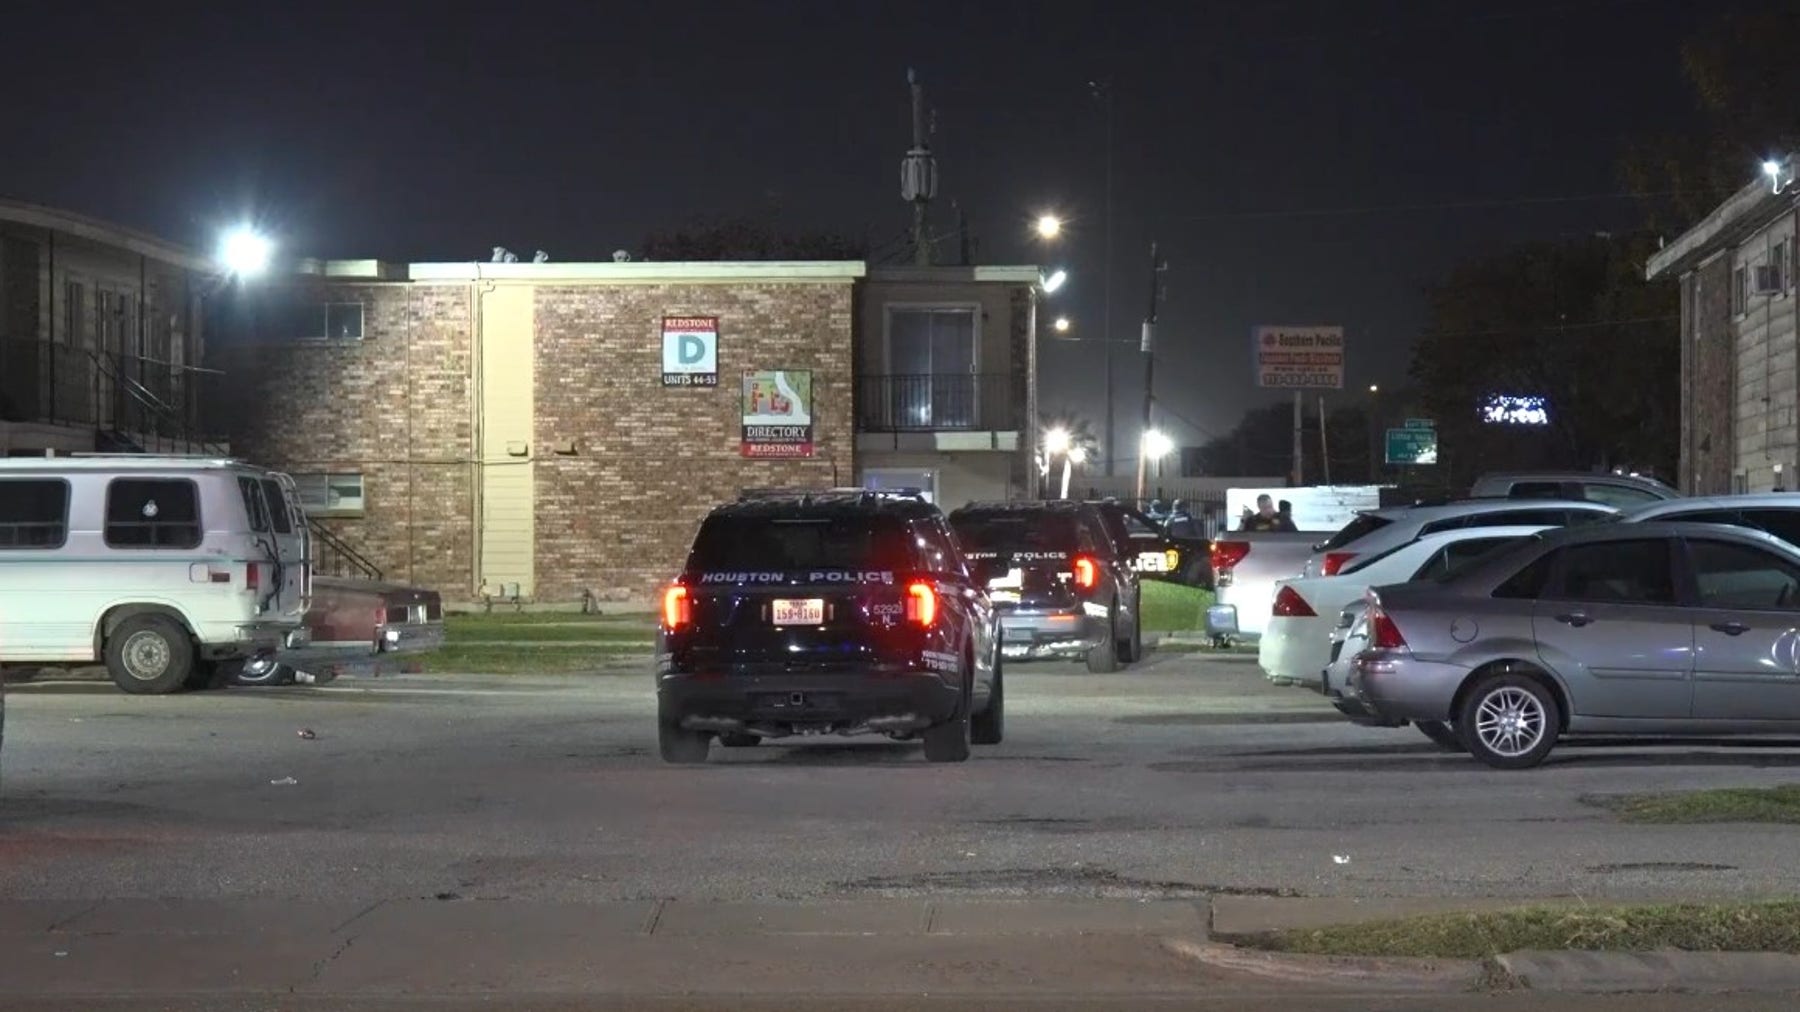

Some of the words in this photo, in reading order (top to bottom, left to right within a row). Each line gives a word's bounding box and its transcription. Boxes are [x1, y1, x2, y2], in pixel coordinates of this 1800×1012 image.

[665, 319, 713, 328] REDSTONE
[678, 335, 706, 364] D
[663, 375, 692, 384] UNITS
[746, 426, 808, 437] DIRECTORY
[750, 443, 802, 453] REDSTONE
[1013, 551, 1068, 560] POLICE
[702, 572, 784, 583] HOUSTON
[809, 571, 894, 583] POLICE
